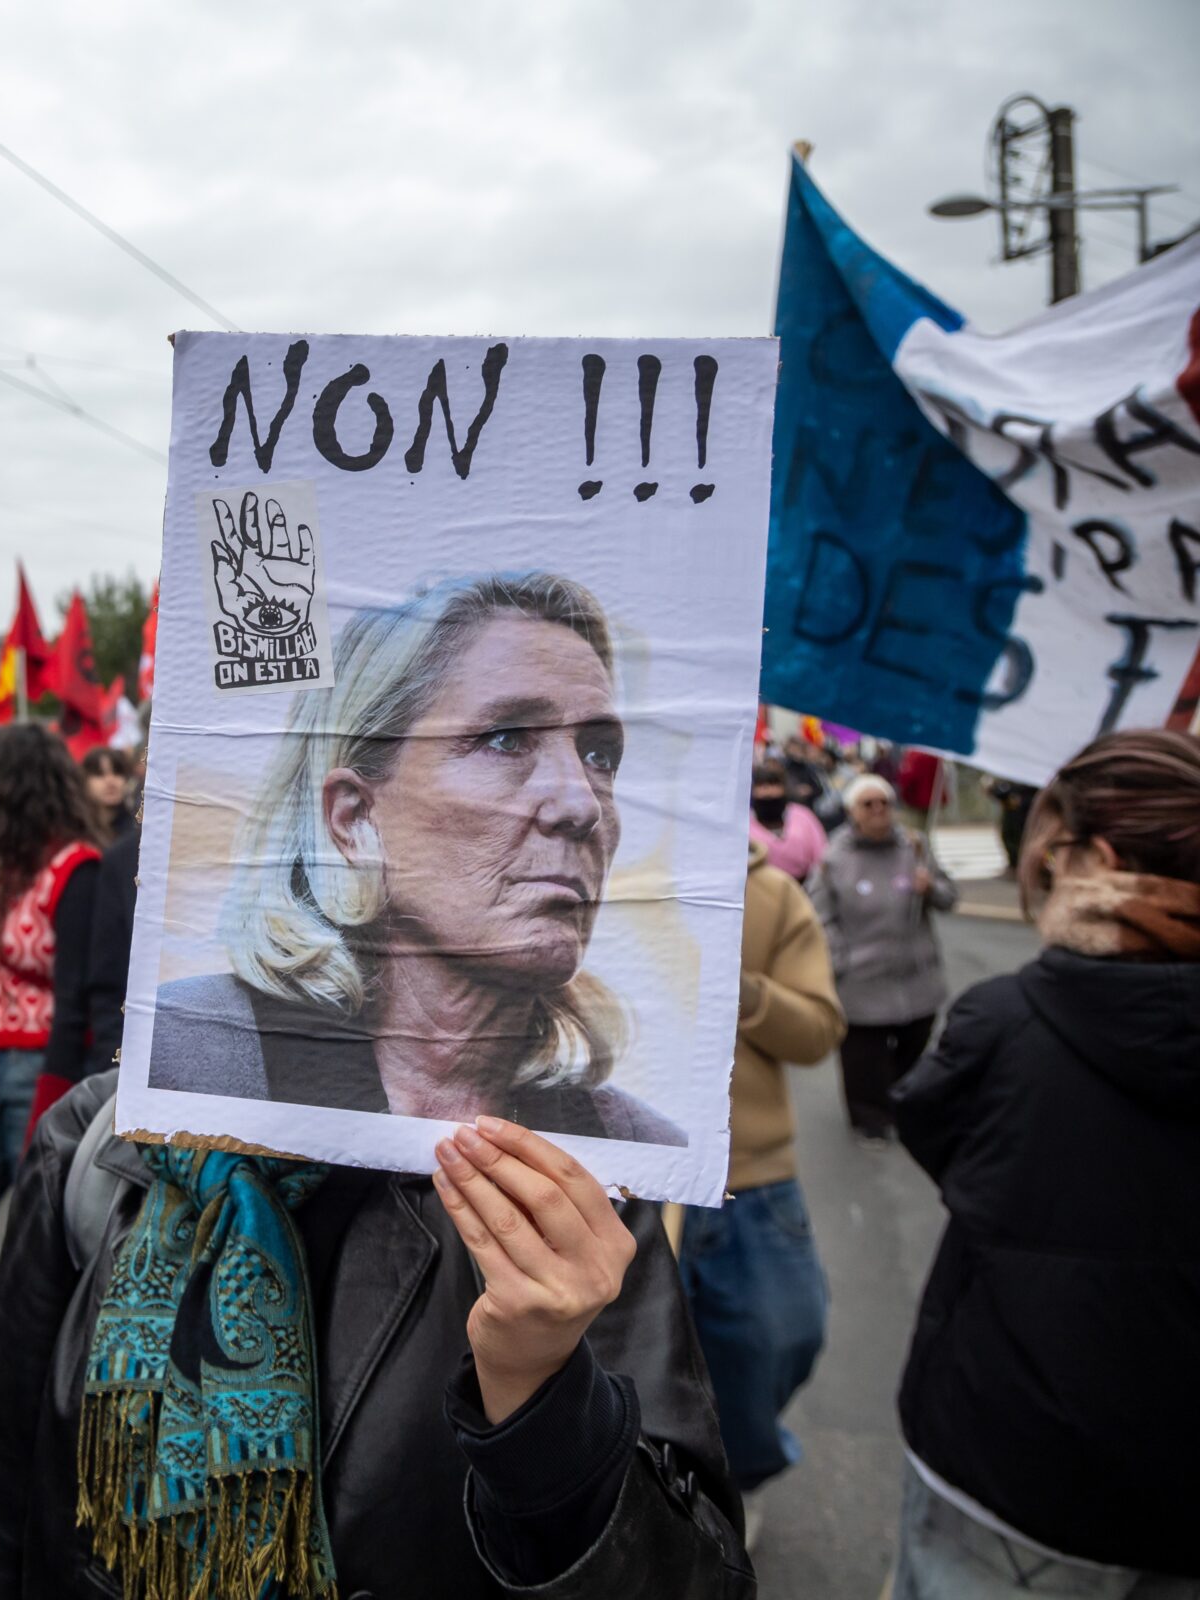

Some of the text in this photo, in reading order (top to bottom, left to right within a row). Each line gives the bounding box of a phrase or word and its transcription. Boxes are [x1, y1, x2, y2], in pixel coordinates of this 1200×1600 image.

[209, 339, 509, 480] NON
[578, 353, 719, 504] !!!
[219, 661, 249, 685] ON
[254, 660, 287, 682] EST
